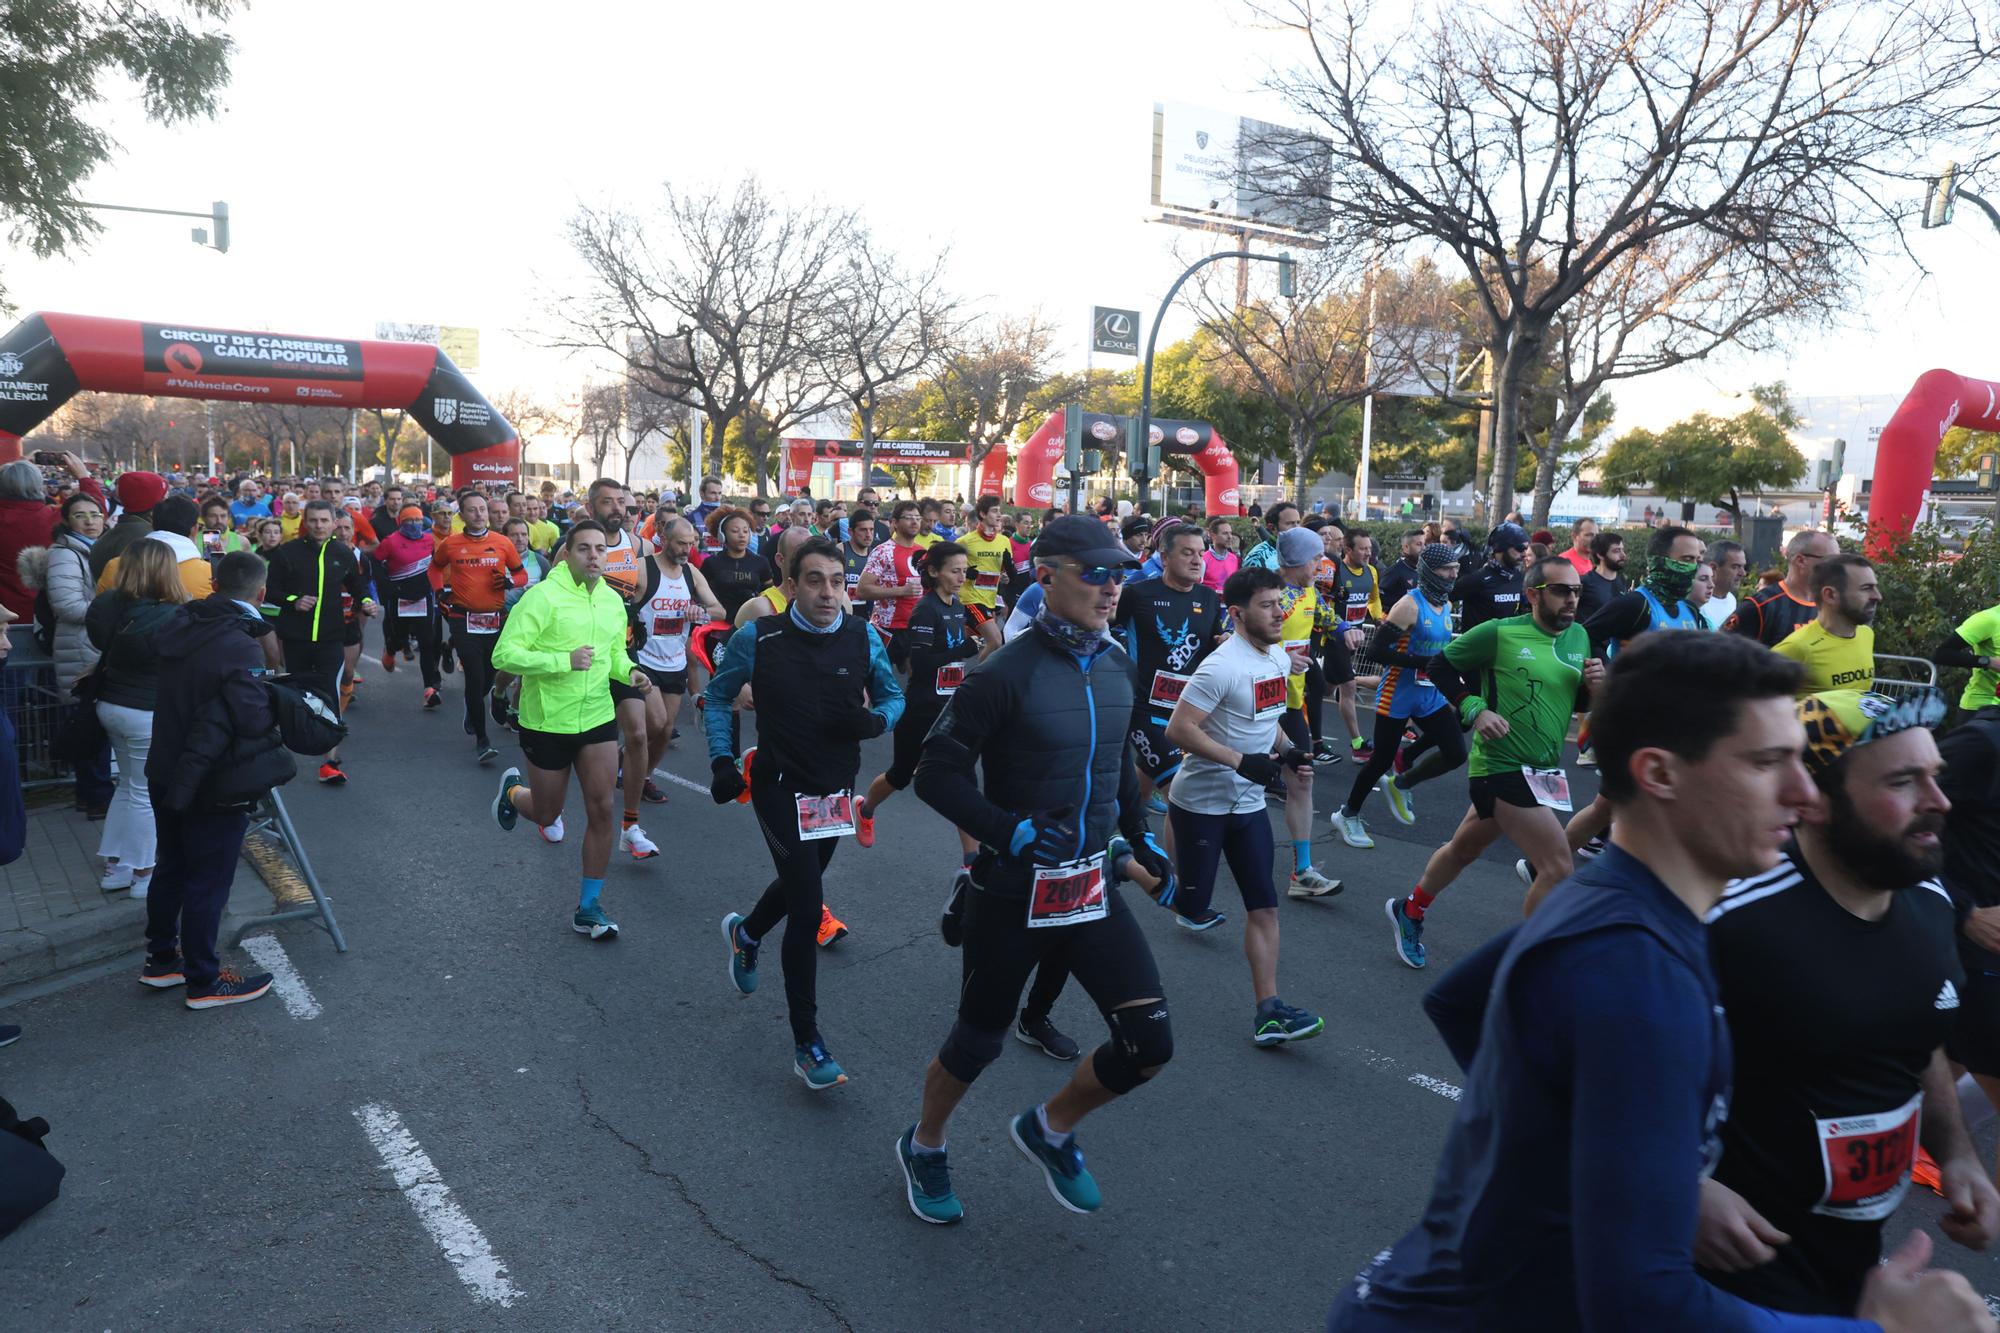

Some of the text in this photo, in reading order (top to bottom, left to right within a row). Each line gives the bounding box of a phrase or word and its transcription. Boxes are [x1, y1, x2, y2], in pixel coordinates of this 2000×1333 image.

[160, 329, 346, 354] CIRCUIT DE CARRERES
[1097, 339, 1137, 350] LEXUS
[735, 572, 752, 580] TDM
[1258, 680, 1281, 701] 2637
[1044, 874, 1091, 904] 2607
